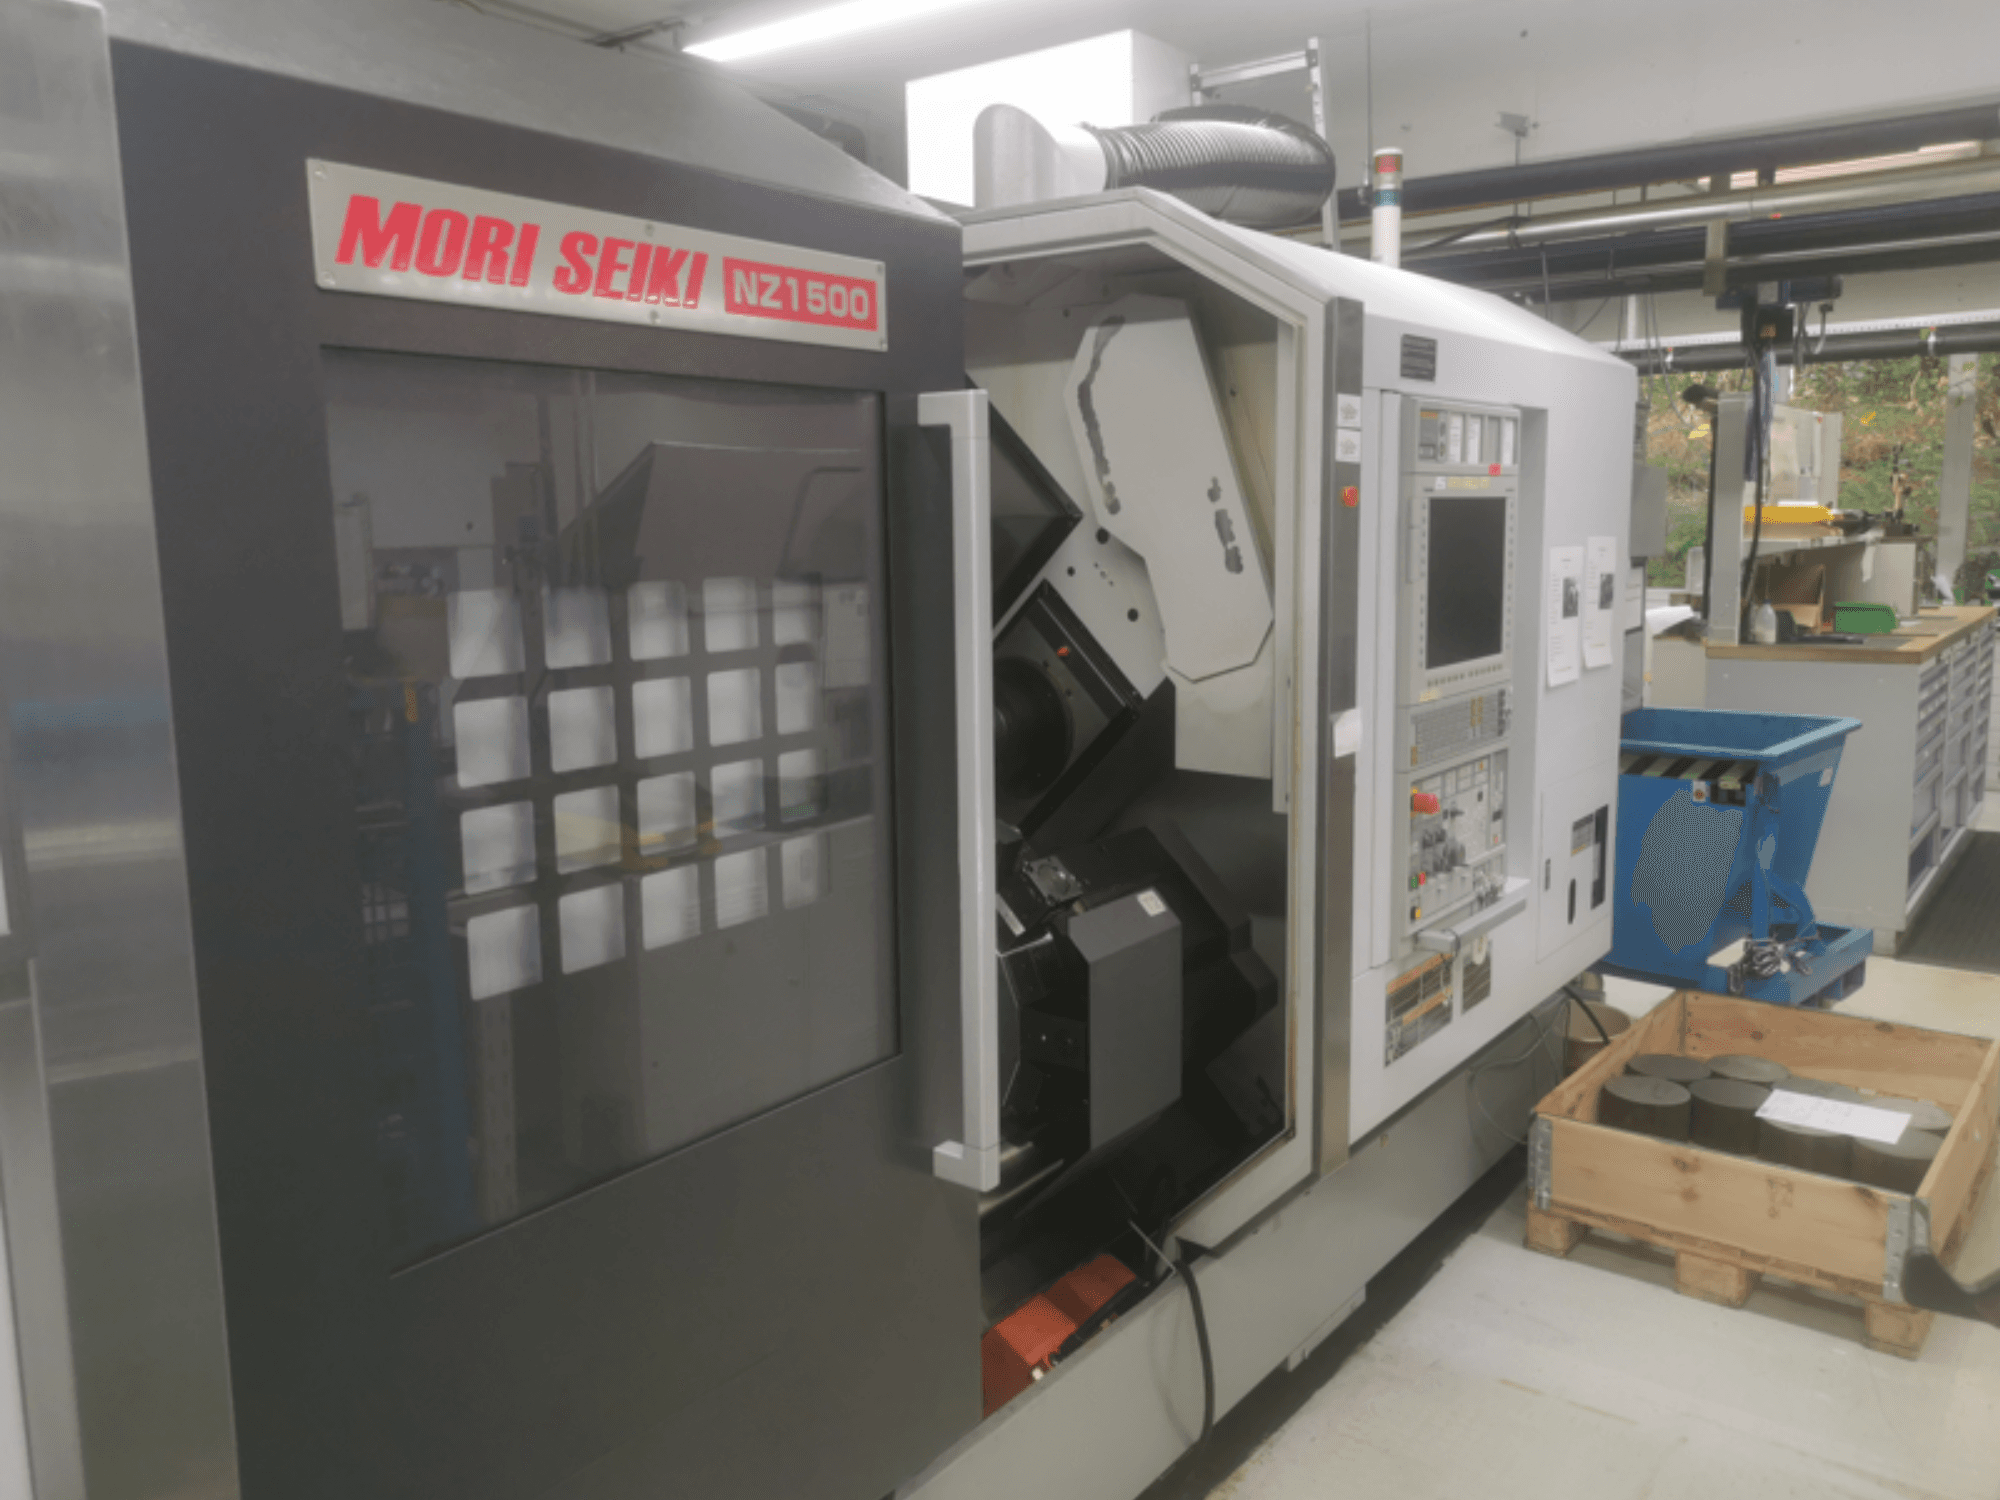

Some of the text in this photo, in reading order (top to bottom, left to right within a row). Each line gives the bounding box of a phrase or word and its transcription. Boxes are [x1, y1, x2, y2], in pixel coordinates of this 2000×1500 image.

[335, 194, 869, 321] MORI SEIKI NZ1500
